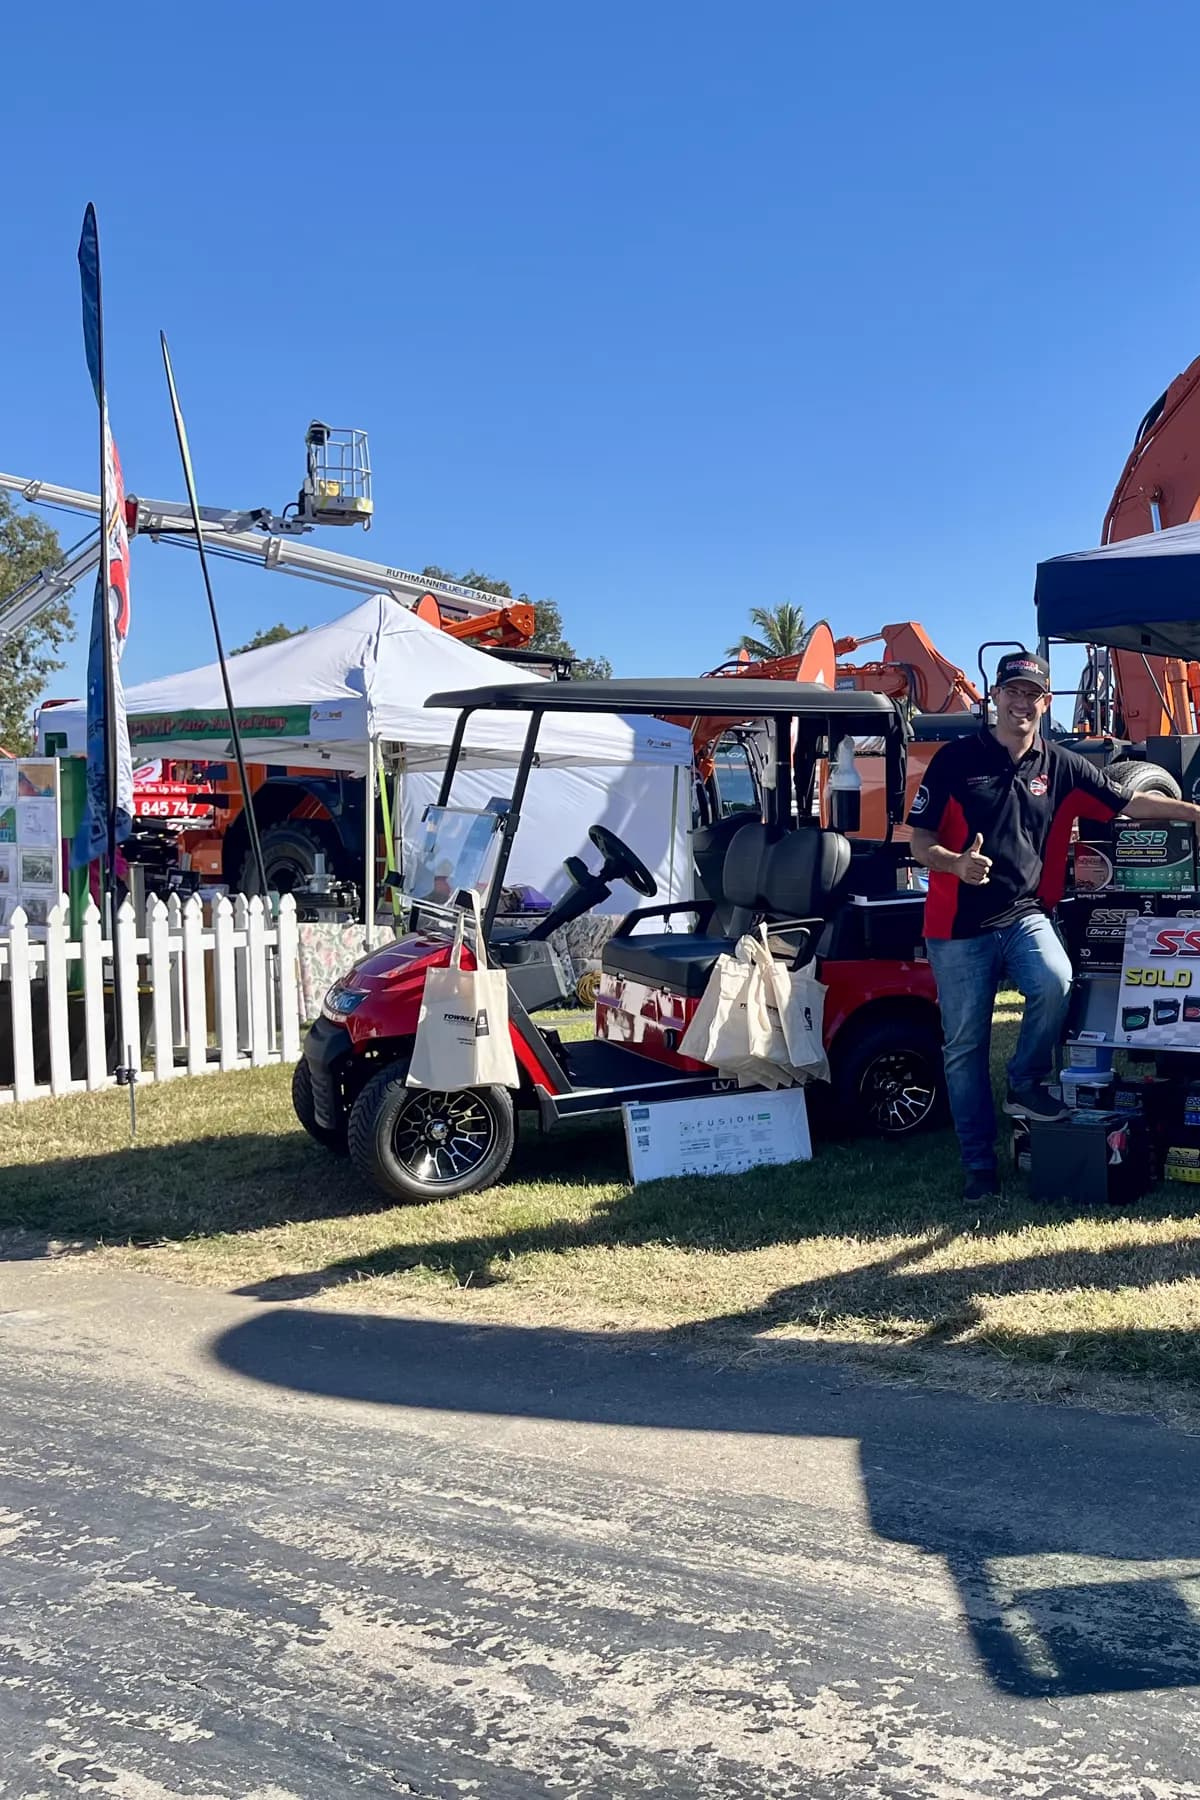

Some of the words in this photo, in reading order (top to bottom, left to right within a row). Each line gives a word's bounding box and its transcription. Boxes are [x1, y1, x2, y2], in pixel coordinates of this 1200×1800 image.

[386, 568, 440, 588] RUTHMANN
[141, 802, 169, 815] 845
[171, 801, 196, 815] 747
[1116, 830, 1168, 847] SSB
[1125, 967, 1193, 989] SOLD
[697, 1114, 755, 1128] FUSION
